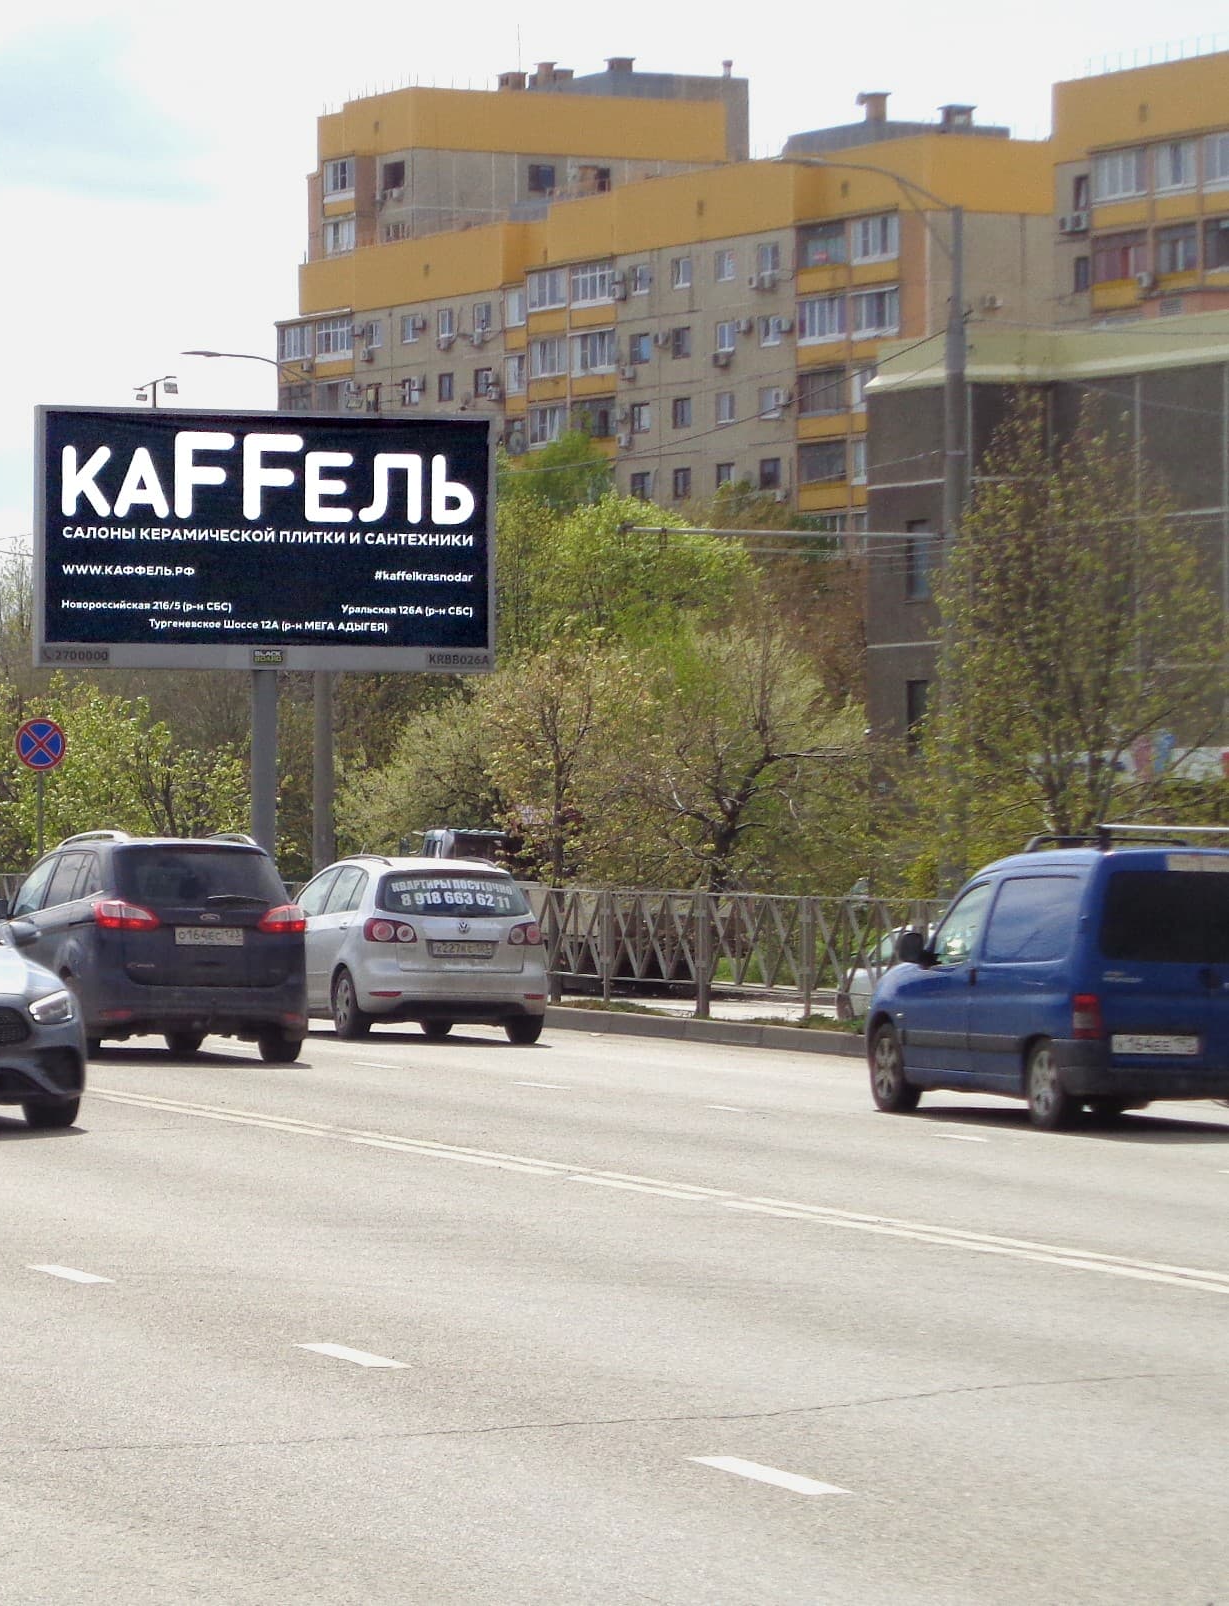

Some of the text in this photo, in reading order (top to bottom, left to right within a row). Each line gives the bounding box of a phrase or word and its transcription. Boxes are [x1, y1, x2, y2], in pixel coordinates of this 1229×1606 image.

[62, 526, 473, 547] САЛОНЫ КЕРАМИЧЕСКОЙ ПЛИТКИ И САНТЕХНИКИ
[62, 564, 196, 577] WWW.КАФФЕЛЬ.РФ
[374, 570, 474, 583] #kaffelkrasnodar
[61, 599, 232, 613] Новороссийская 216/5 (р-н СБС)
[341, 603, 473, 618] Уральская 126А (р-н СБС)
[148, 618, 389, 634] Тургеневское Шоссе 12А (р-н МЕГА АДЫГЕЯ)
[391, 879, 513, 896] КВАРТИРЫ ПОСУТОЧНО
[400, 891, 511, 909] 8 918 663 62 11
